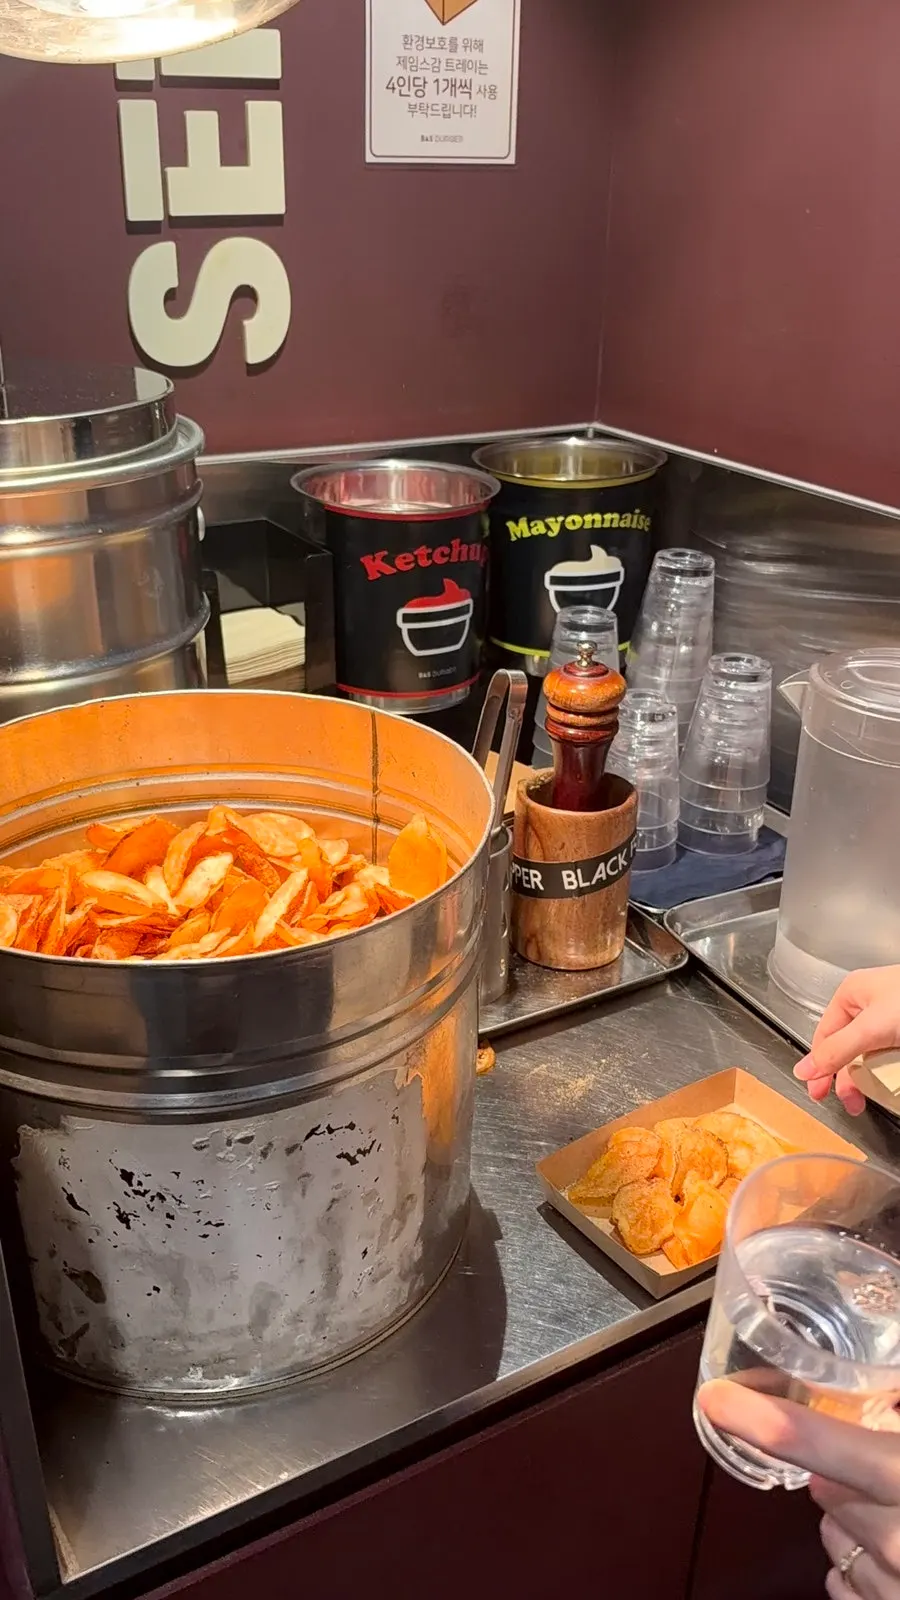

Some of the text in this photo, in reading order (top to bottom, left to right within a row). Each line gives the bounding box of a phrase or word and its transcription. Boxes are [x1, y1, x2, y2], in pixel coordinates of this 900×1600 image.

[402, 34, 484, 54] 환경보호를 위해
[396, 55, 489, 75] 제임스감 트레이는
[385, 75, 498, 101] 4인당 1개씩 사용
[407, 102, 477, 119] 부탁드립니다!
[505, 508, 651, 542] Mayonnaise
[561, 848, 628, 891] BLACK
